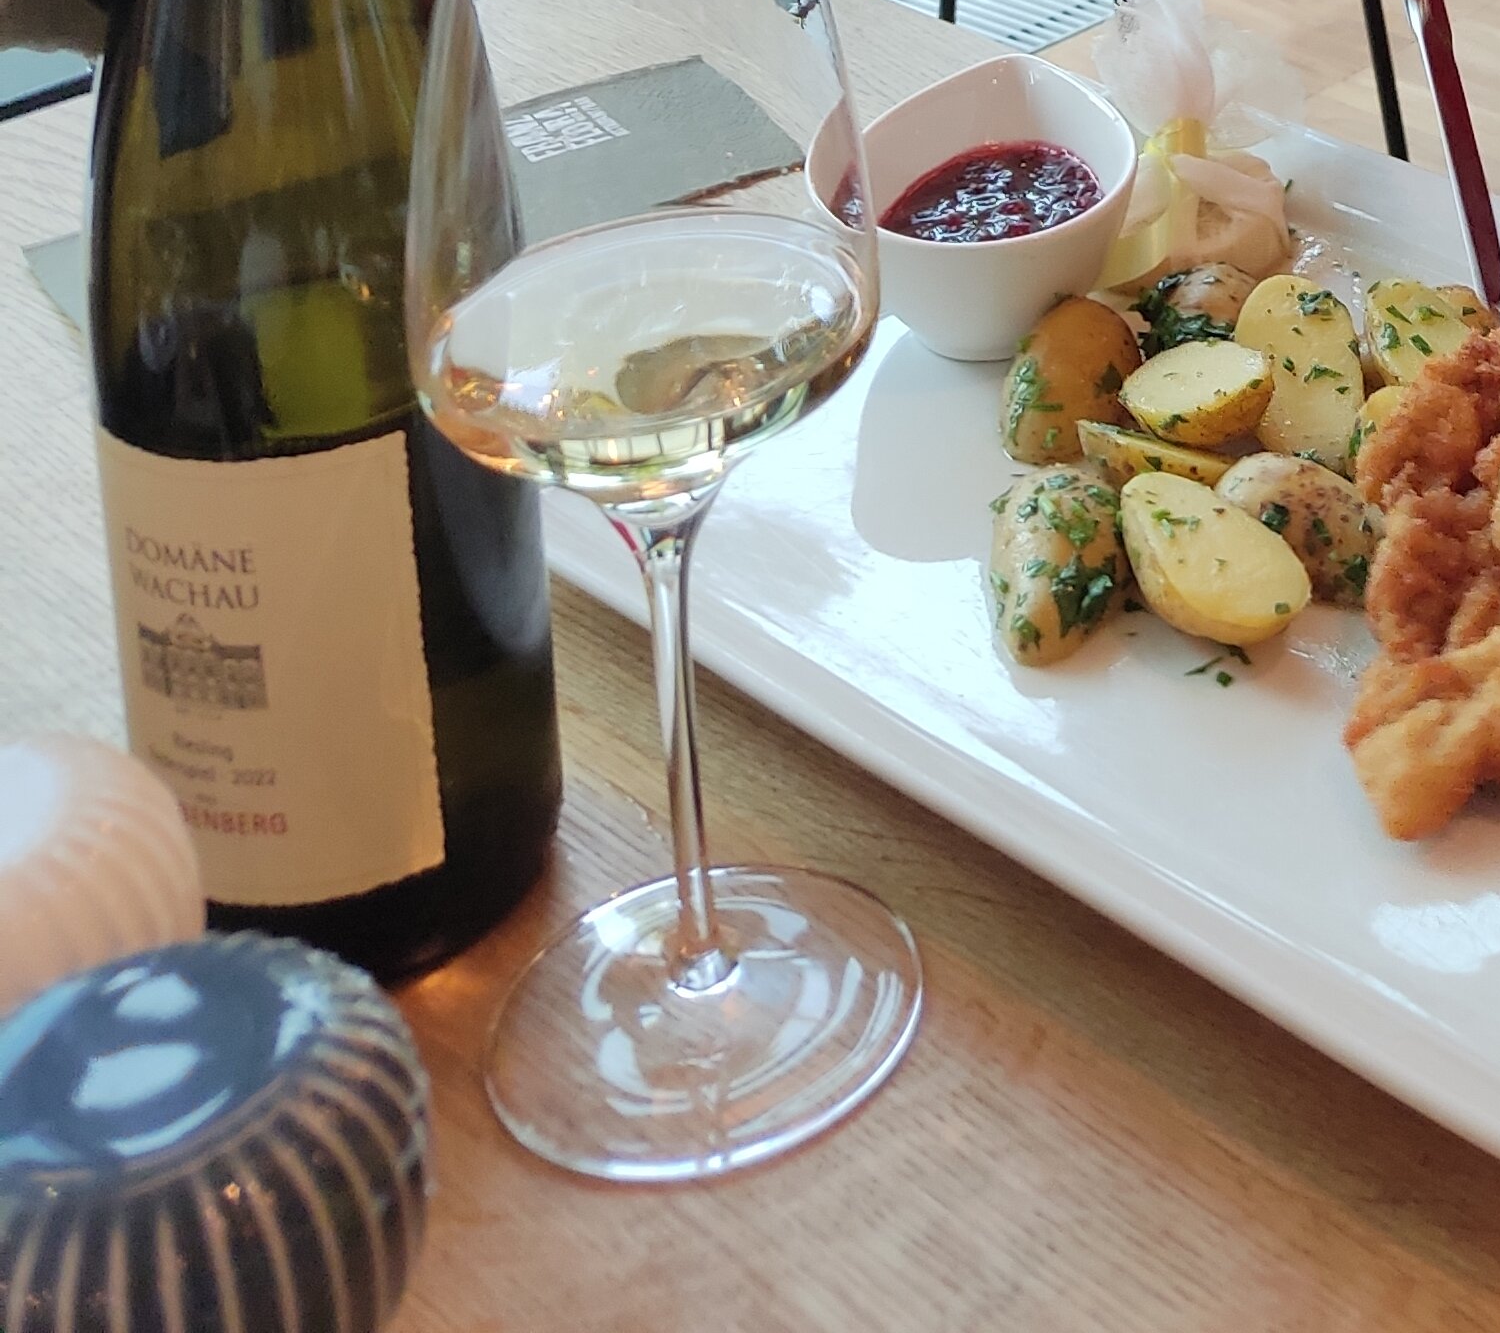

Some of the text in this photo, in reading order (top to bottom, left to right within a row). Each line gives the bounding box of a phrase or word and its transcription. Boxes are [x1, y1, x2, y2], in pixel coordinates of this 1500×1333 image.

[125, 526, 256, 573] DOMÄNE
[129, 562, 259, 610] WACHAU
[178, 804, 288, 836] ENBERG
